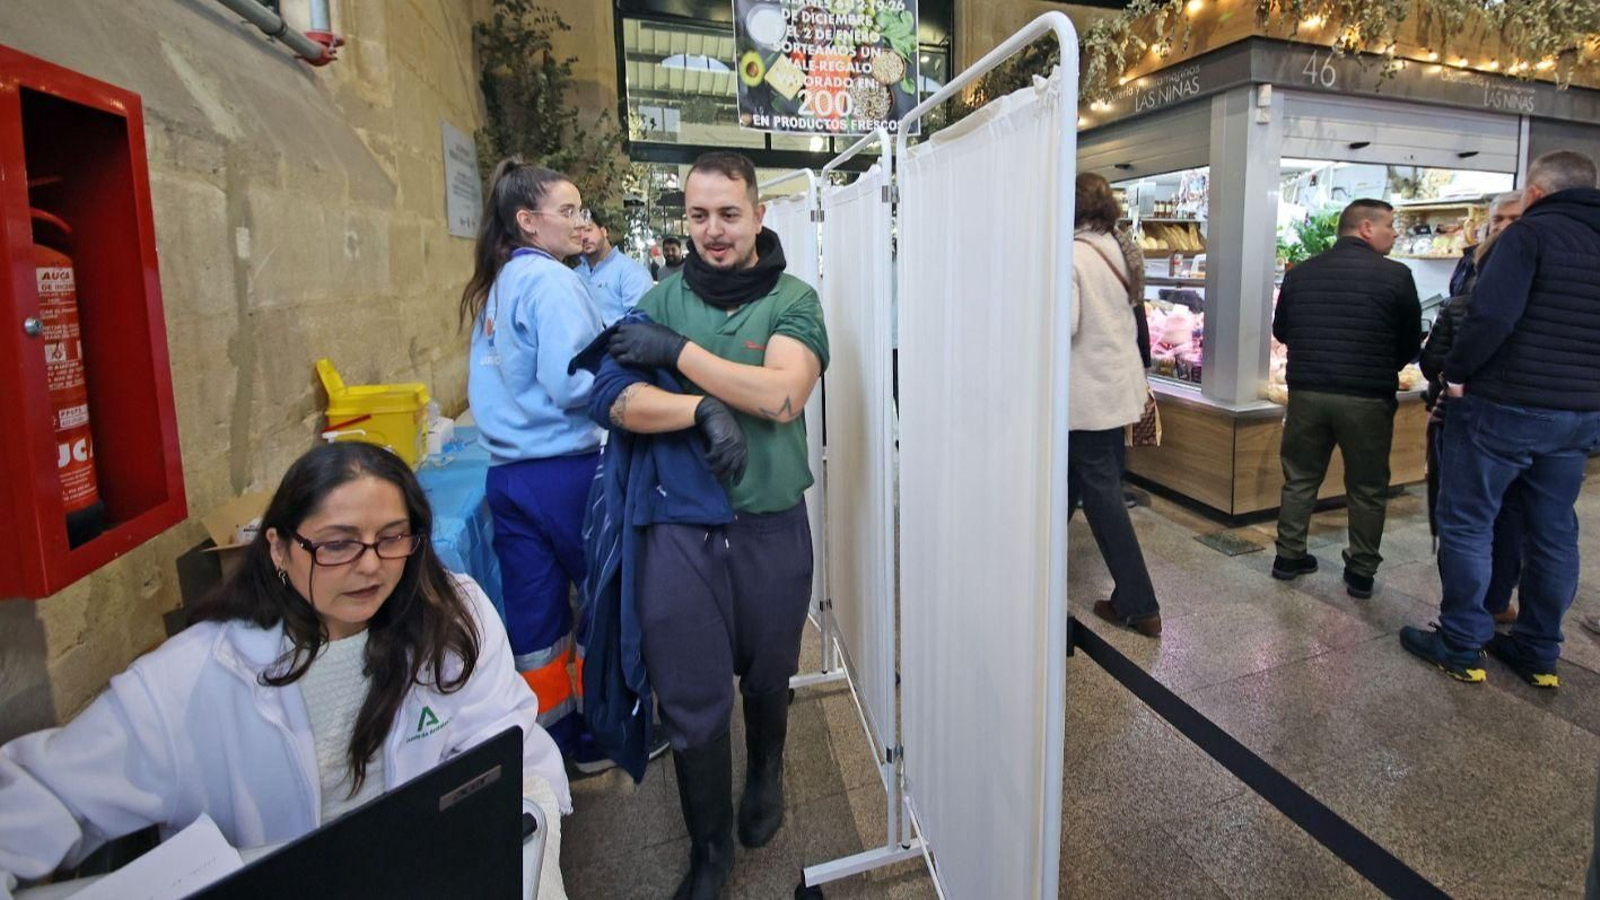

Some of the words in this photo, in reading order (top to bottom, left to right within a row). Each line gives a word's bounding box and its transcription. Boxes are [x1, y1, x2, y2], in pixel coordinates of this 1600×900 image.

[781, 8, 798, 22] DE
[787, 25, 799, 37] EL
[803, 28, 812, 38] 2
[815, 29, 832, 41] DE
[836, 30, 880, 43] ENERO
[775, 41, 857, 57] SORTEAMOS
[861, 46, 882, 58] UN
[1302, 49, 1336, 88] 46
[1135, 91, 1155, 113] LAS
[1484, 87, 1502, 108] LAS
[753, 114, 770, 127] EN
[773, 115, 848, 131] PRODUCTOS
